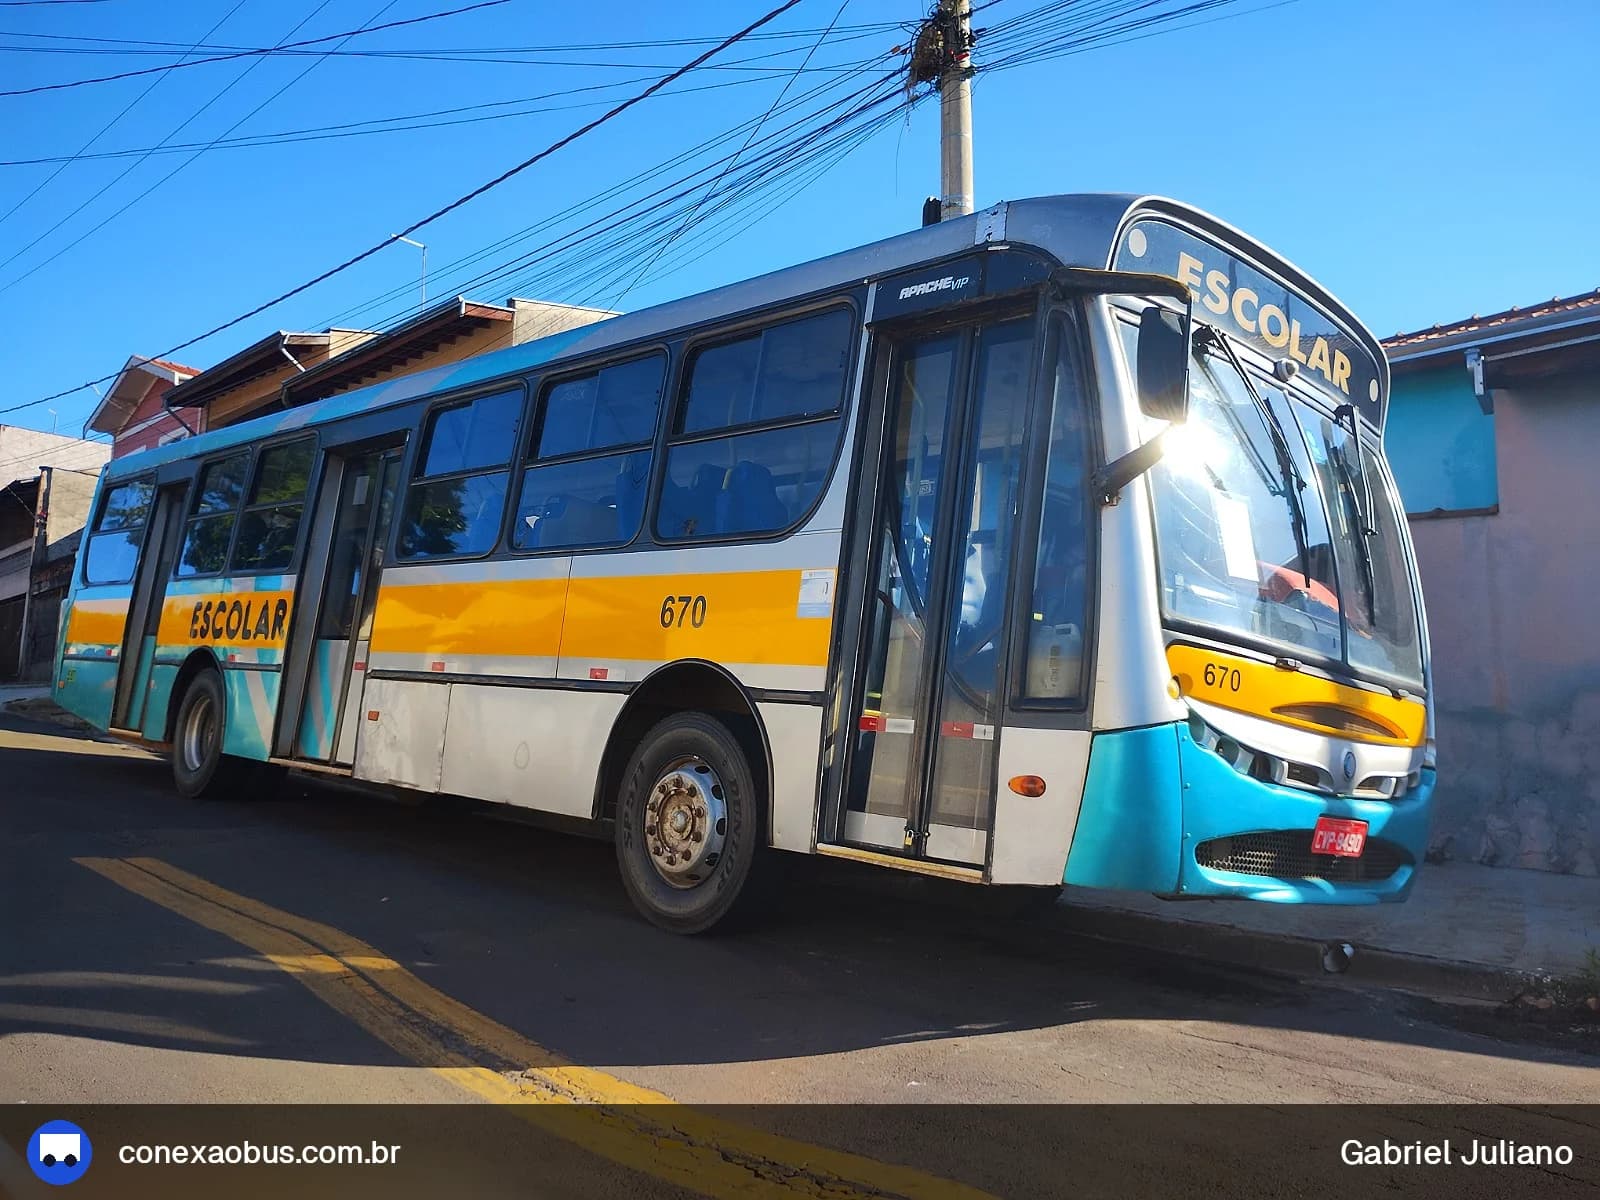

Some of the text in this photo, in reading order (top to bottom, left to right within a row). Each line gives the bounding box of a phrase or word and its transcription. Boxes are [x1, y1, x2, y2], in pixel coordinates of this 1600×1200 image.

[899, 276, 970, 300] APACHE VIP
[1177, 251, 1351, 395] ESCOLAR
[189, 598, 288, 641] ESCOLAR
[660, 595, 707, 629] 670
[1203, 663, 1241, 692] 670
